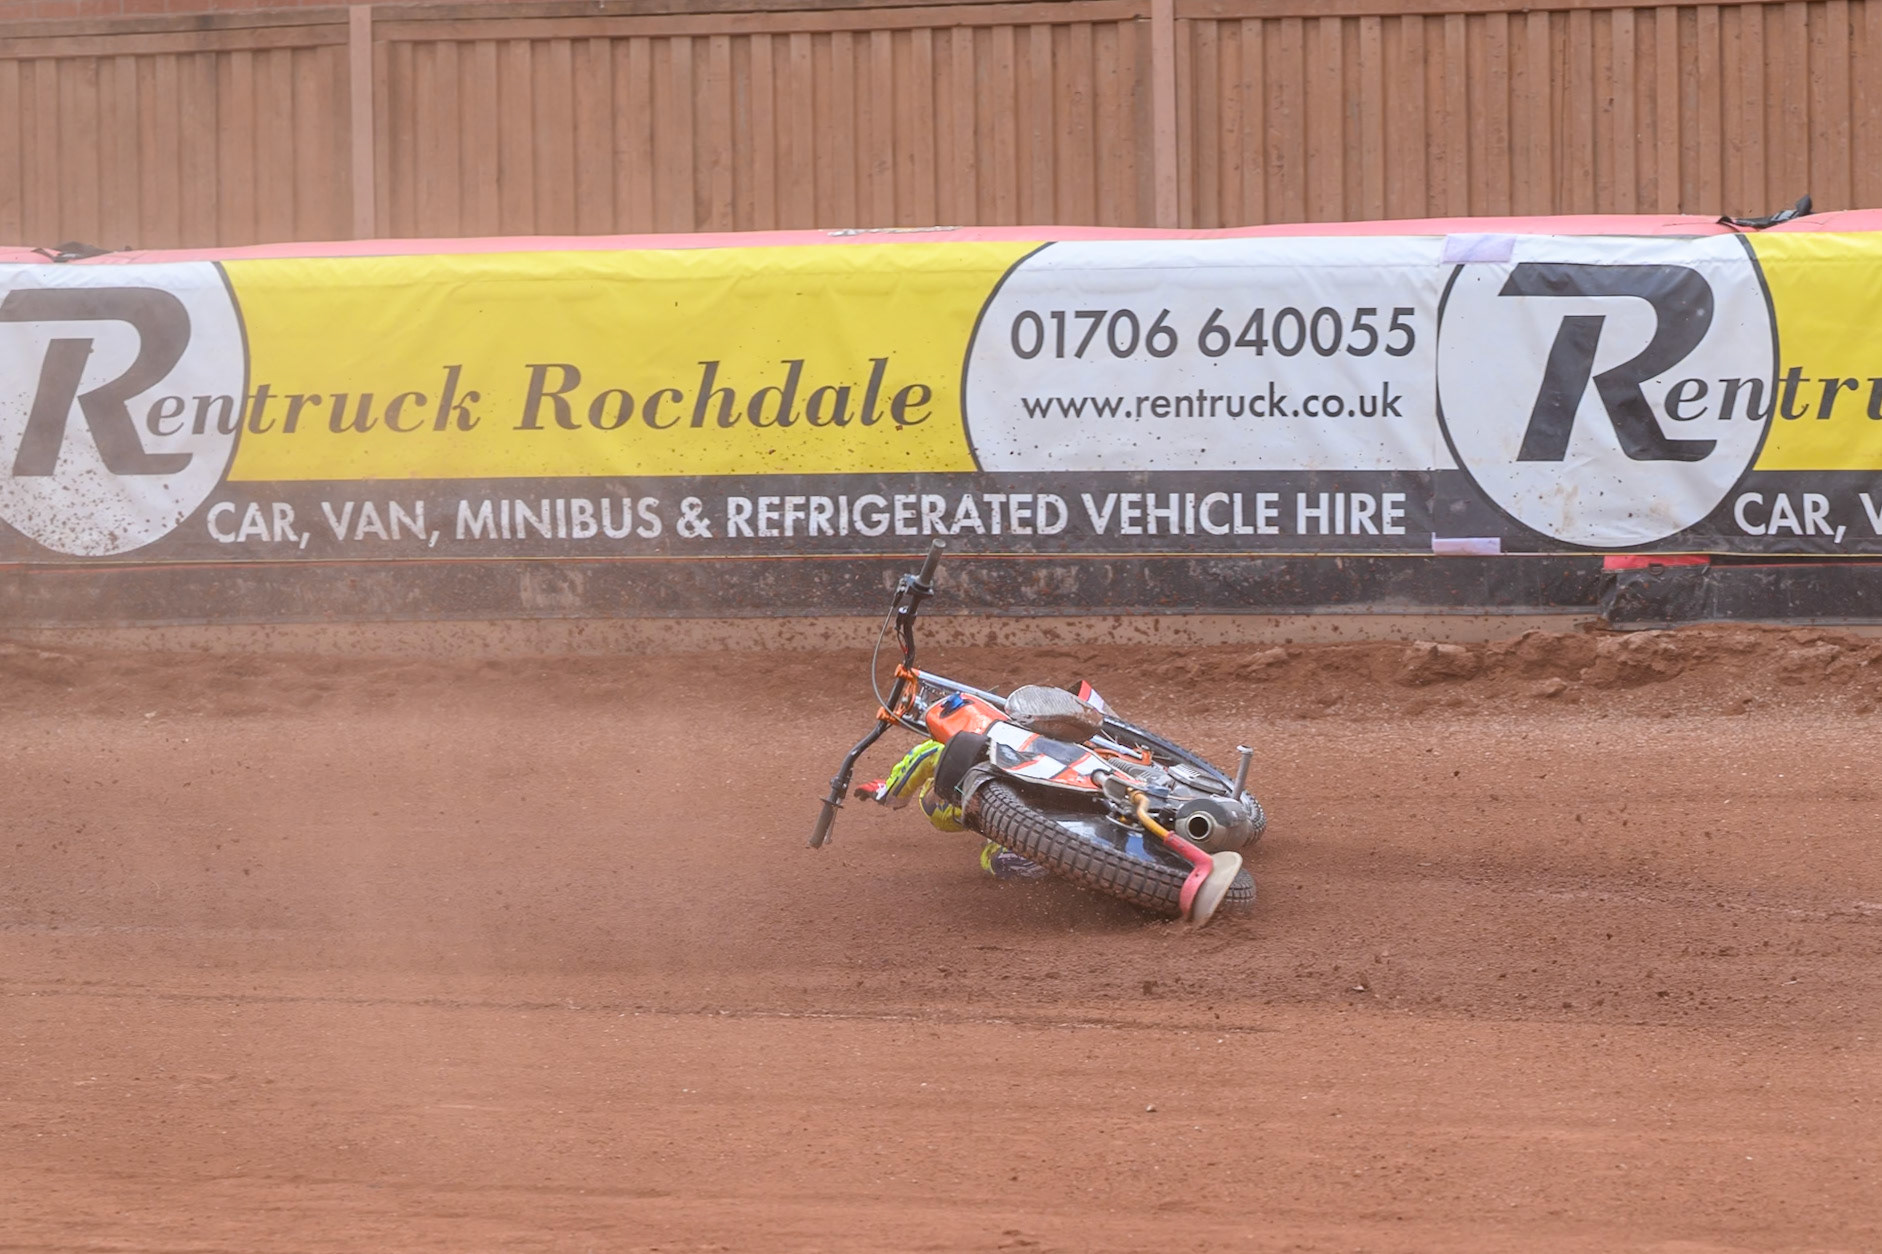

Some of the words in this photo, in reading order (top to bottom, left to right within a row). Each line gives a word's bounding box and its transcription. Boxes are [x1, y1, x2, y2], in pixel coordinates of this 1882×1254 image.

[1011, 308, 1179, 359] 01706
[1197, 306, 1416, 357] 640055
[0, 287, 481, 476] Rentruck
[513, 356, 933, 431] Rochdale
[1021, 381, 1403, 419] www.rentruck.co.uk
[207, 502, 308, 549] CAR,
[321, 500, 440, 547] VAN,
[455, 497, 663, 540] MINIBUS
[676, 496, 713, 539] &
[726, 493, 1069, 538] REFRIGERATED
[1080, 492, 1280, 536] VEHICLE
[1296, 492, 1406, 535] HIRE
[1734, 493, 1846, 544] CAR,
